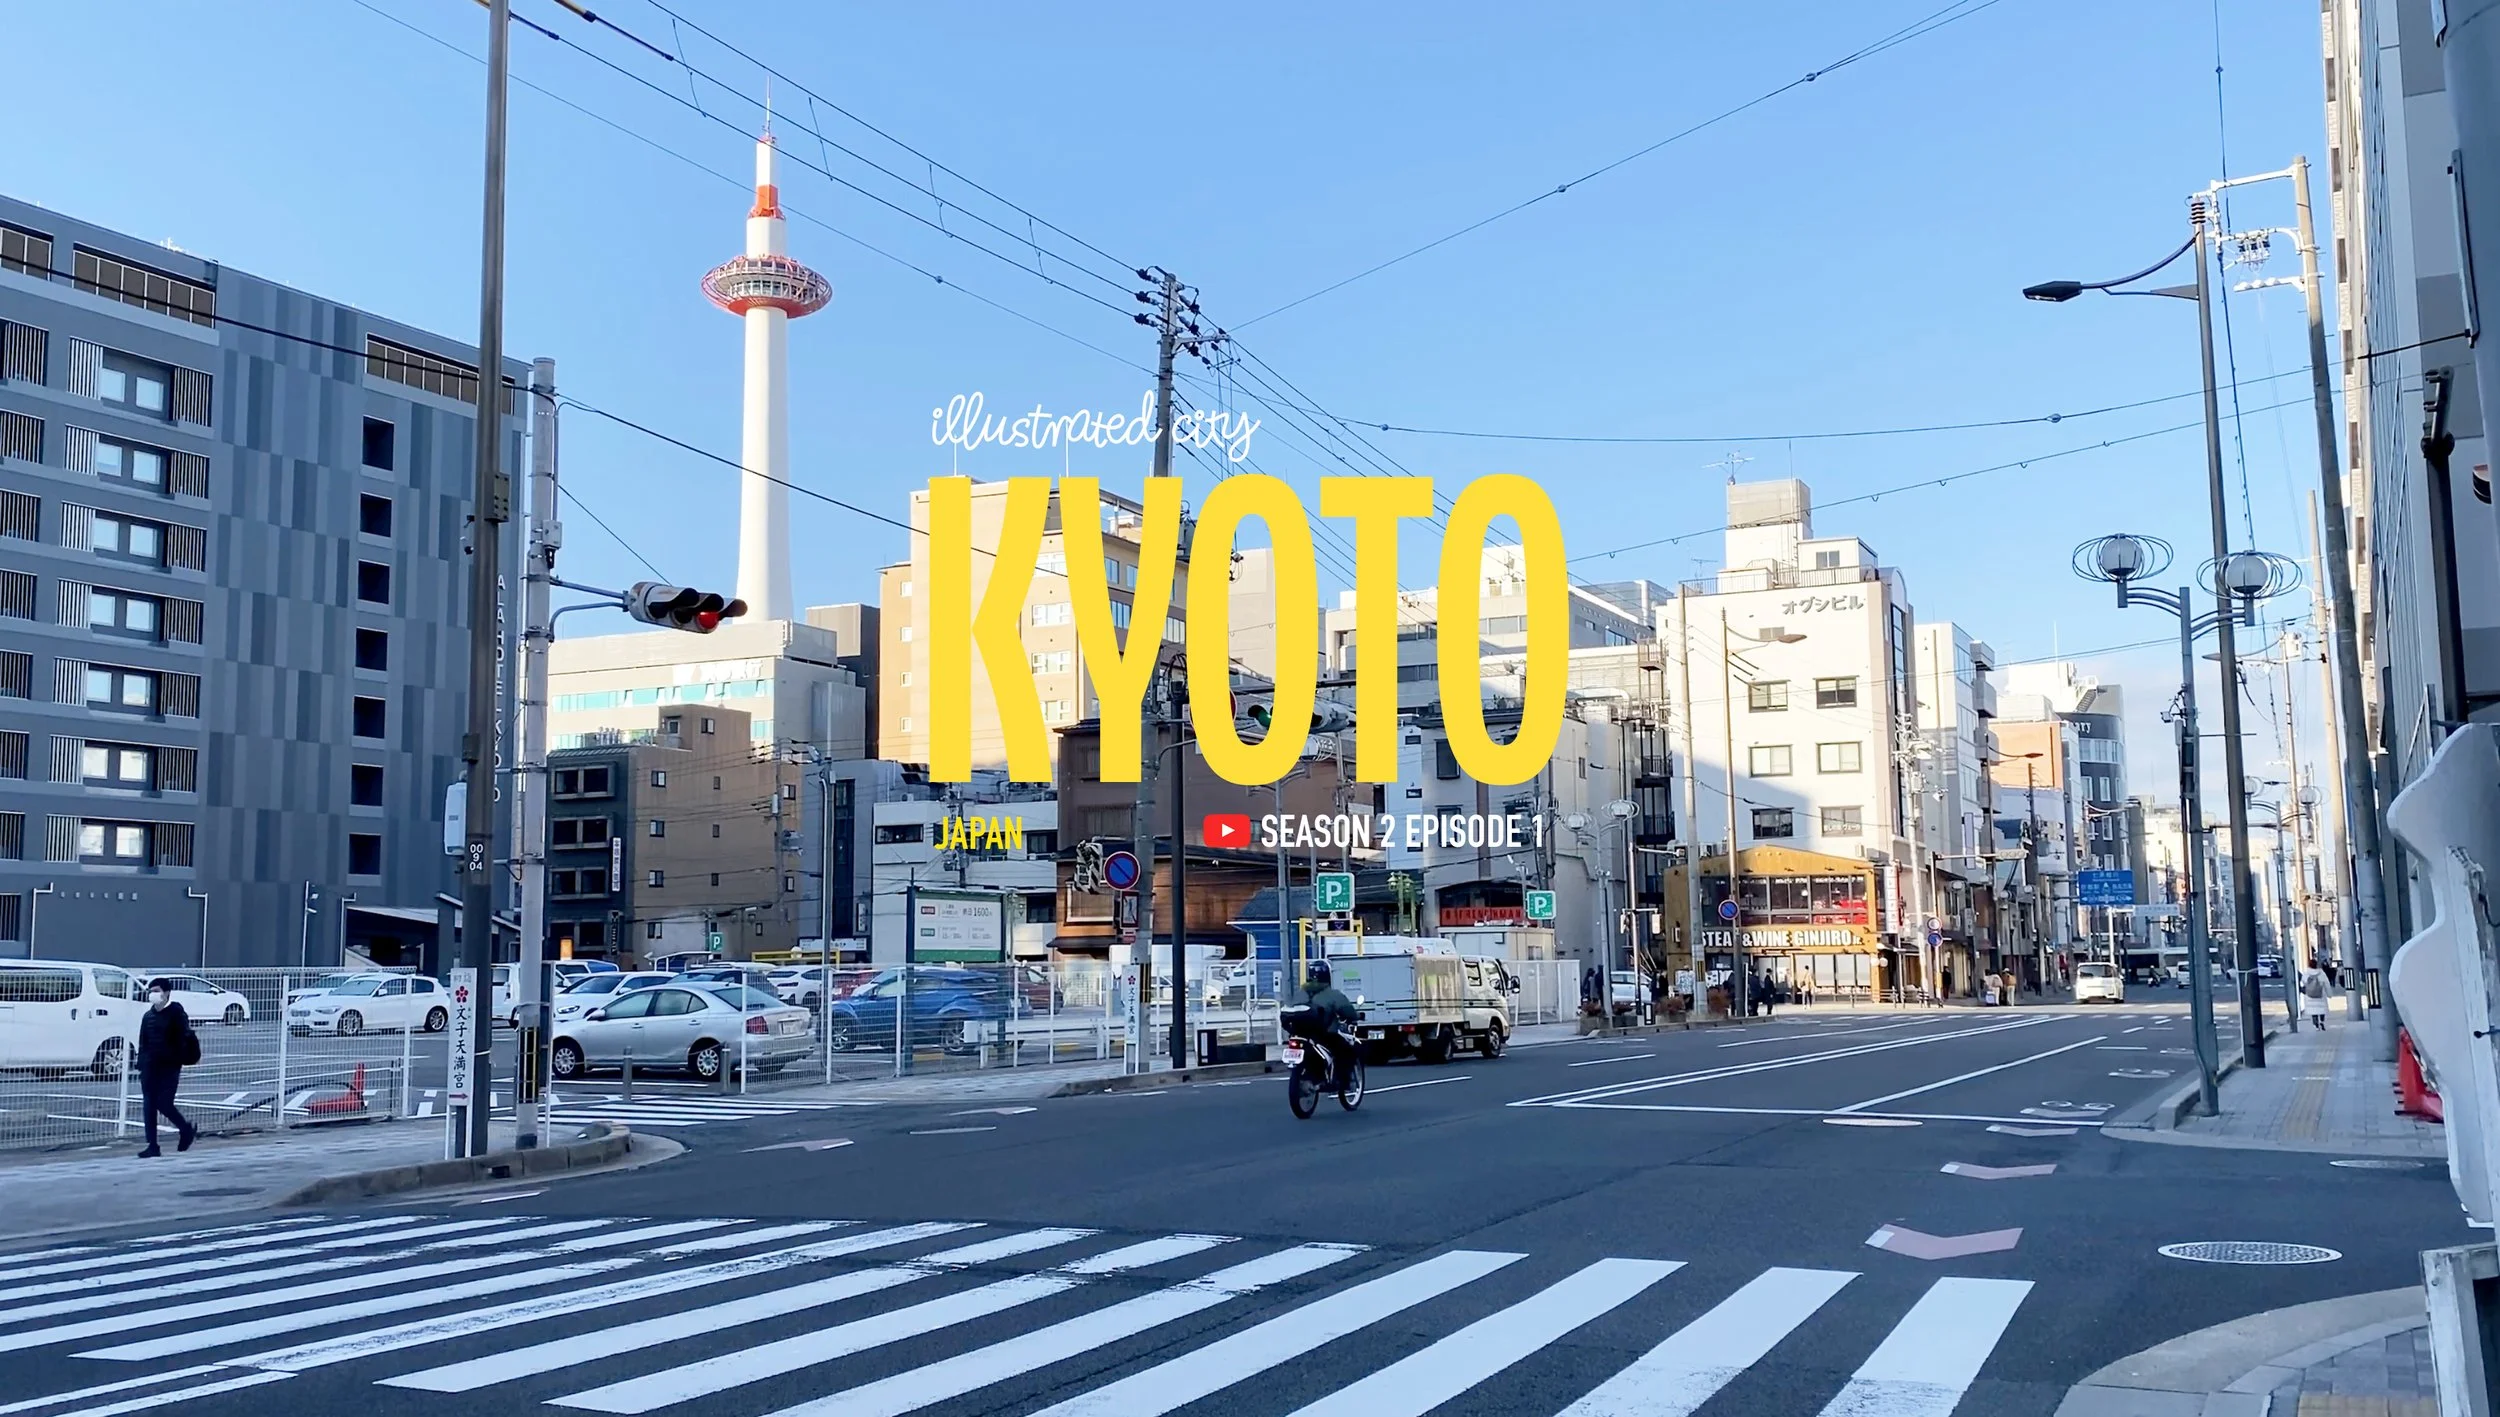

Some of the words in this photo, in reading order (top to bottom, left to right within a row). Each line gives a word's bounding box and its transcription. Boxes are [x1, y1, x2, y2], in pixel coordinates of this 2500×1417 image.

[1781, 595, 1865, 616] オグシビル
[495, 630, 505, 713] HOTE
[470, 844, 484, 854] 00
[472, 853, 480, 861] 9
[469, 861, 483, 870] 04
[1325, 880, 1342, 904] P
[1534, 896, 1547, 914] P
[1792, 929, 1851, 946] GINJIRO
[453, 1005, 468, 1089] 文子天満宮
